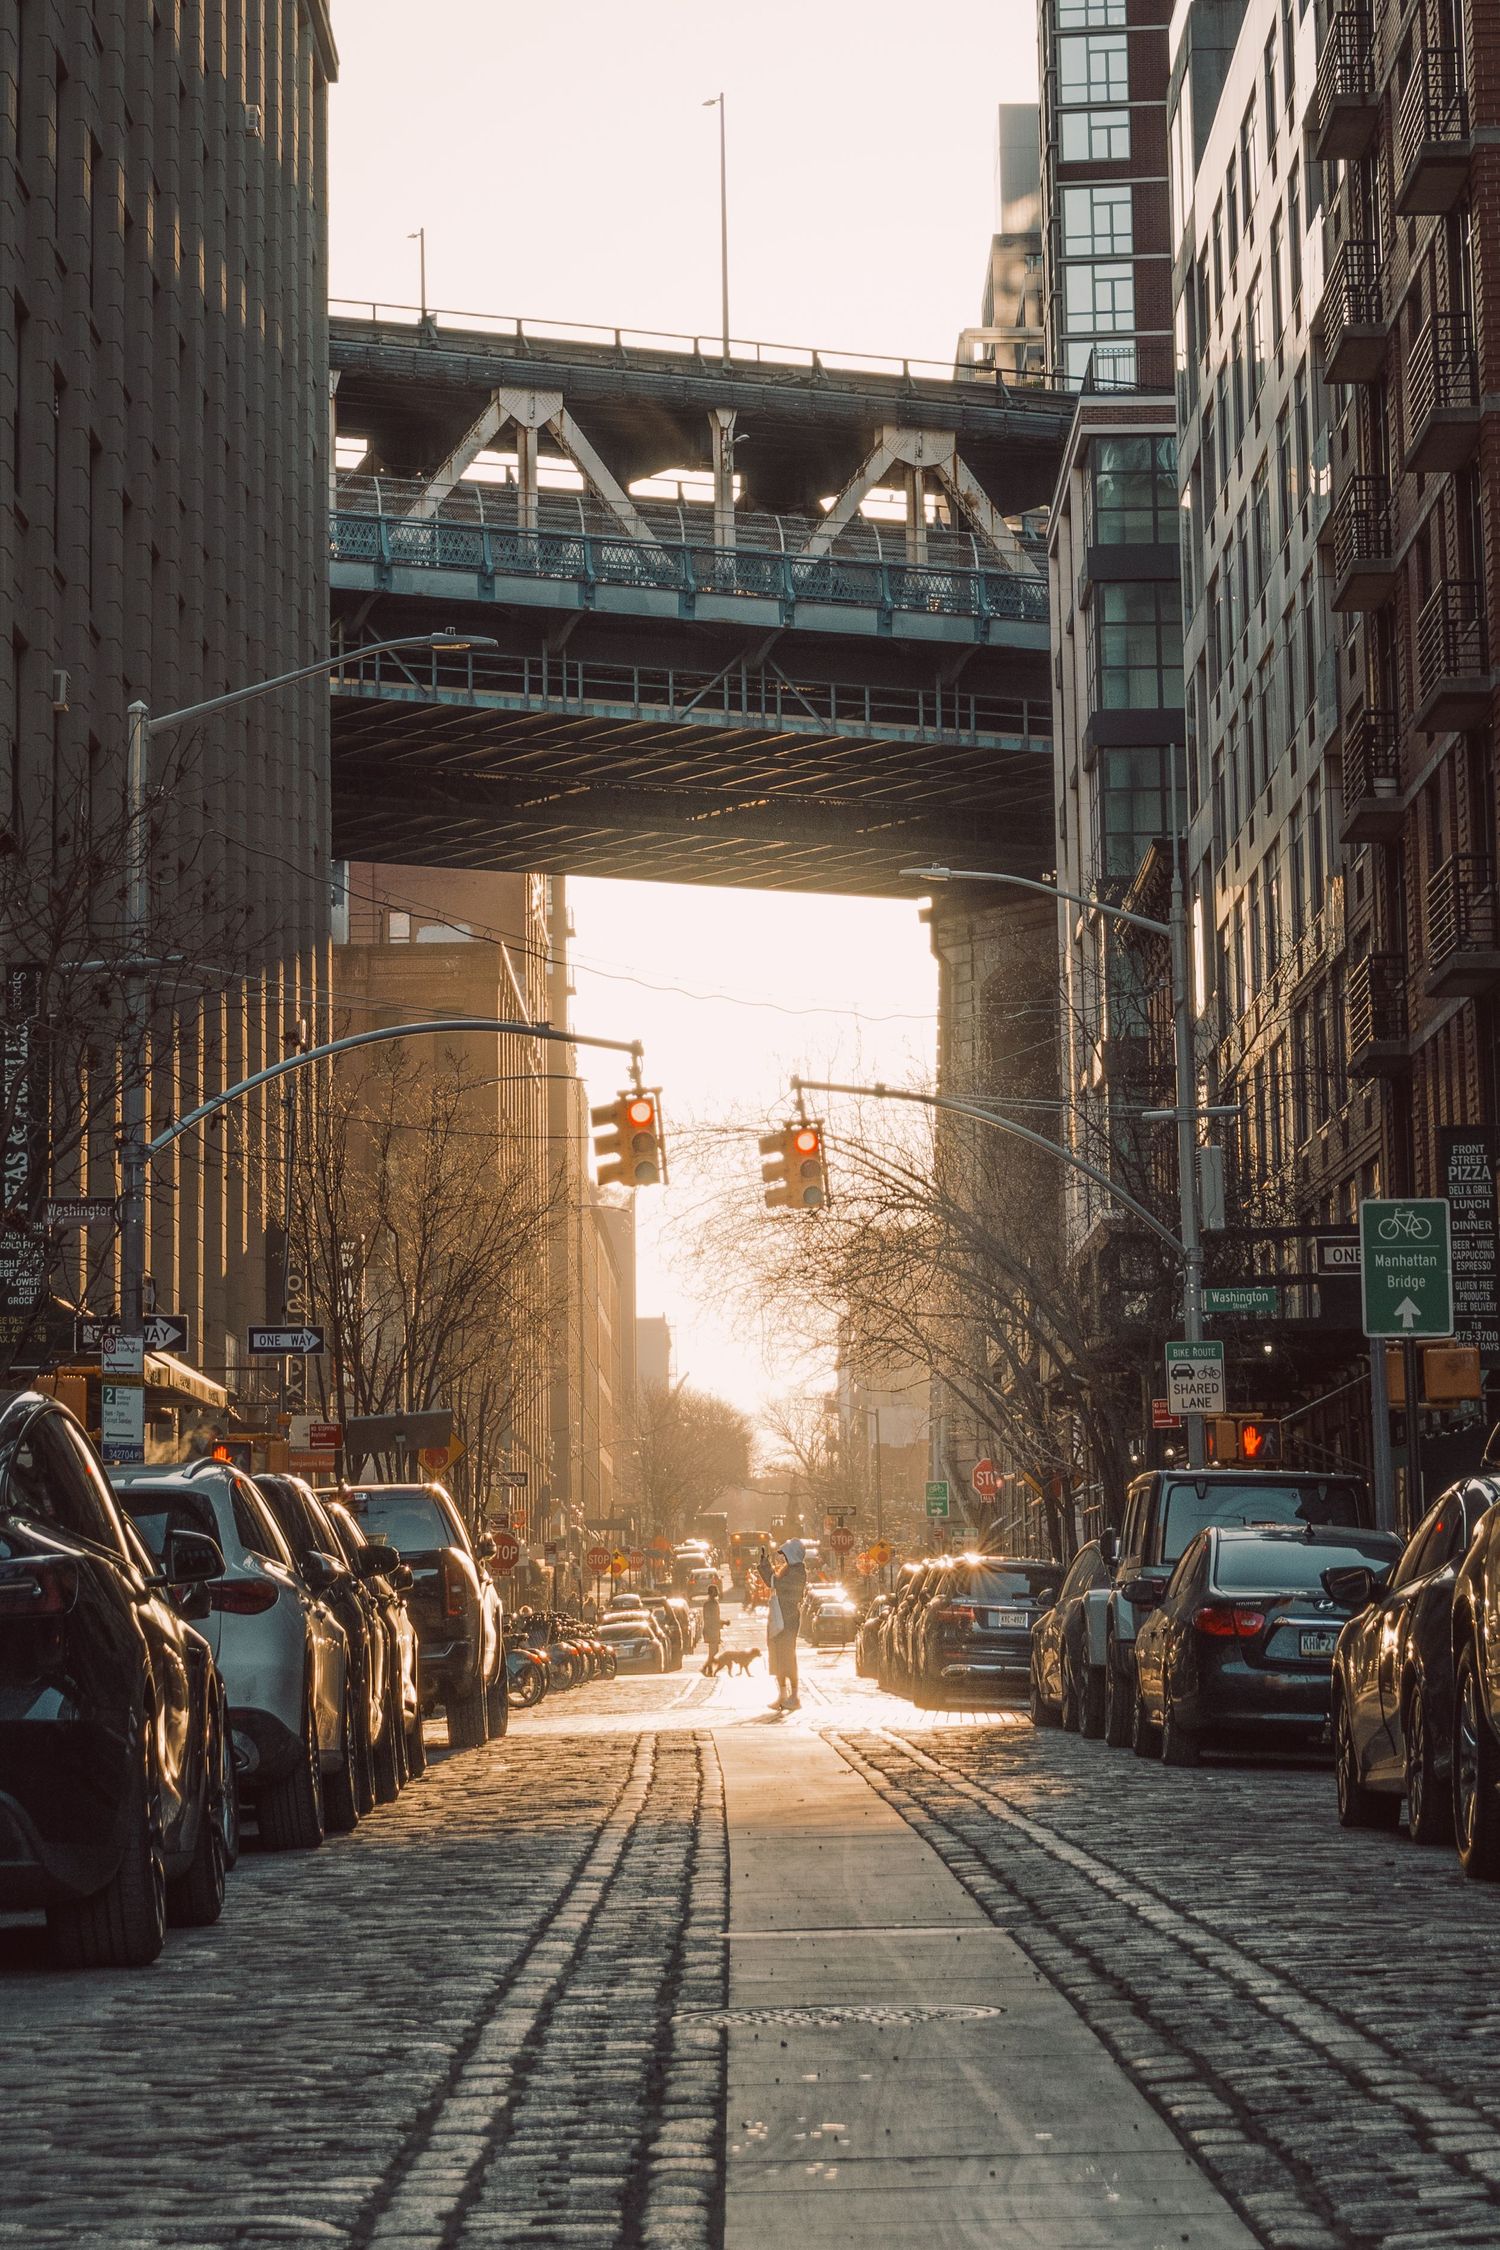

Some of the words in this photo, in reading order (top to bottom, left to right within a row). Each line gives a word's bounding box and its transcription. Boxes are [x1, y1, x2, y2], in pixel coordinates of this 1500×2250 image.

[1452, 1144, 1485, 1154] FRONT
[1450, 1155, 1488, 1164] STREET
[1448, 1166, 1491, 1181] PIZZA
[1449, 1185, 1465, 1195] DELI
[1466, 1185, 1472, 1195] &
[1474, 1185, 1493, 1195] GRILL
[1453, 1199, 1490, 1209] LUNCH
[1467, 1210, 1476, 1220] &
[1452, 1220, 1493, 1230] DINNER
[1452, 1240, 1470, 1250] BEER
[1477, 1240, 1494, 1250] WINE
[1452, 1250, 1496, 1260] CAPPUCCINO
[1375, 1253, 1438, 1268] Manhattan
[1456, 1260, 1492, 1271] ESPRESSO
[1387, 1274, 1426, 1290] Bridge
[1455, 1280, 1478, 1291] GLUTEN
[1479, 1280, 1494, 1291] FREE
[1211, 1290, 1269, 1304] Washington
[1459, 1291, 1491, 1301] PRODUCTS
[1453, 1302, 1468, 1312] FREE
[1470, 1302, 1498, 1312] DELIVERY
[1471, 1321, 1482, 1330] 718
[259, 1334, 281, 1346] ONE
[290, 1334, 313, 1346] WAY
[1480, 1342, 1500, 1351] DAYS
[1173, 1348, 1190, 1358] BIKE
[1192, 1347, 1217, 1358] ROUTE
[1173, 1383, 1220, 1395] SHARED
[106, 1388, 113, 1403] 2
[1181, 1397, 1213, 1409] LANE
[831, 1535, 853, 1545] STOP
[496, 1545, 518, 1560] TOP
[588, 1554, 609, 1565] STOP
